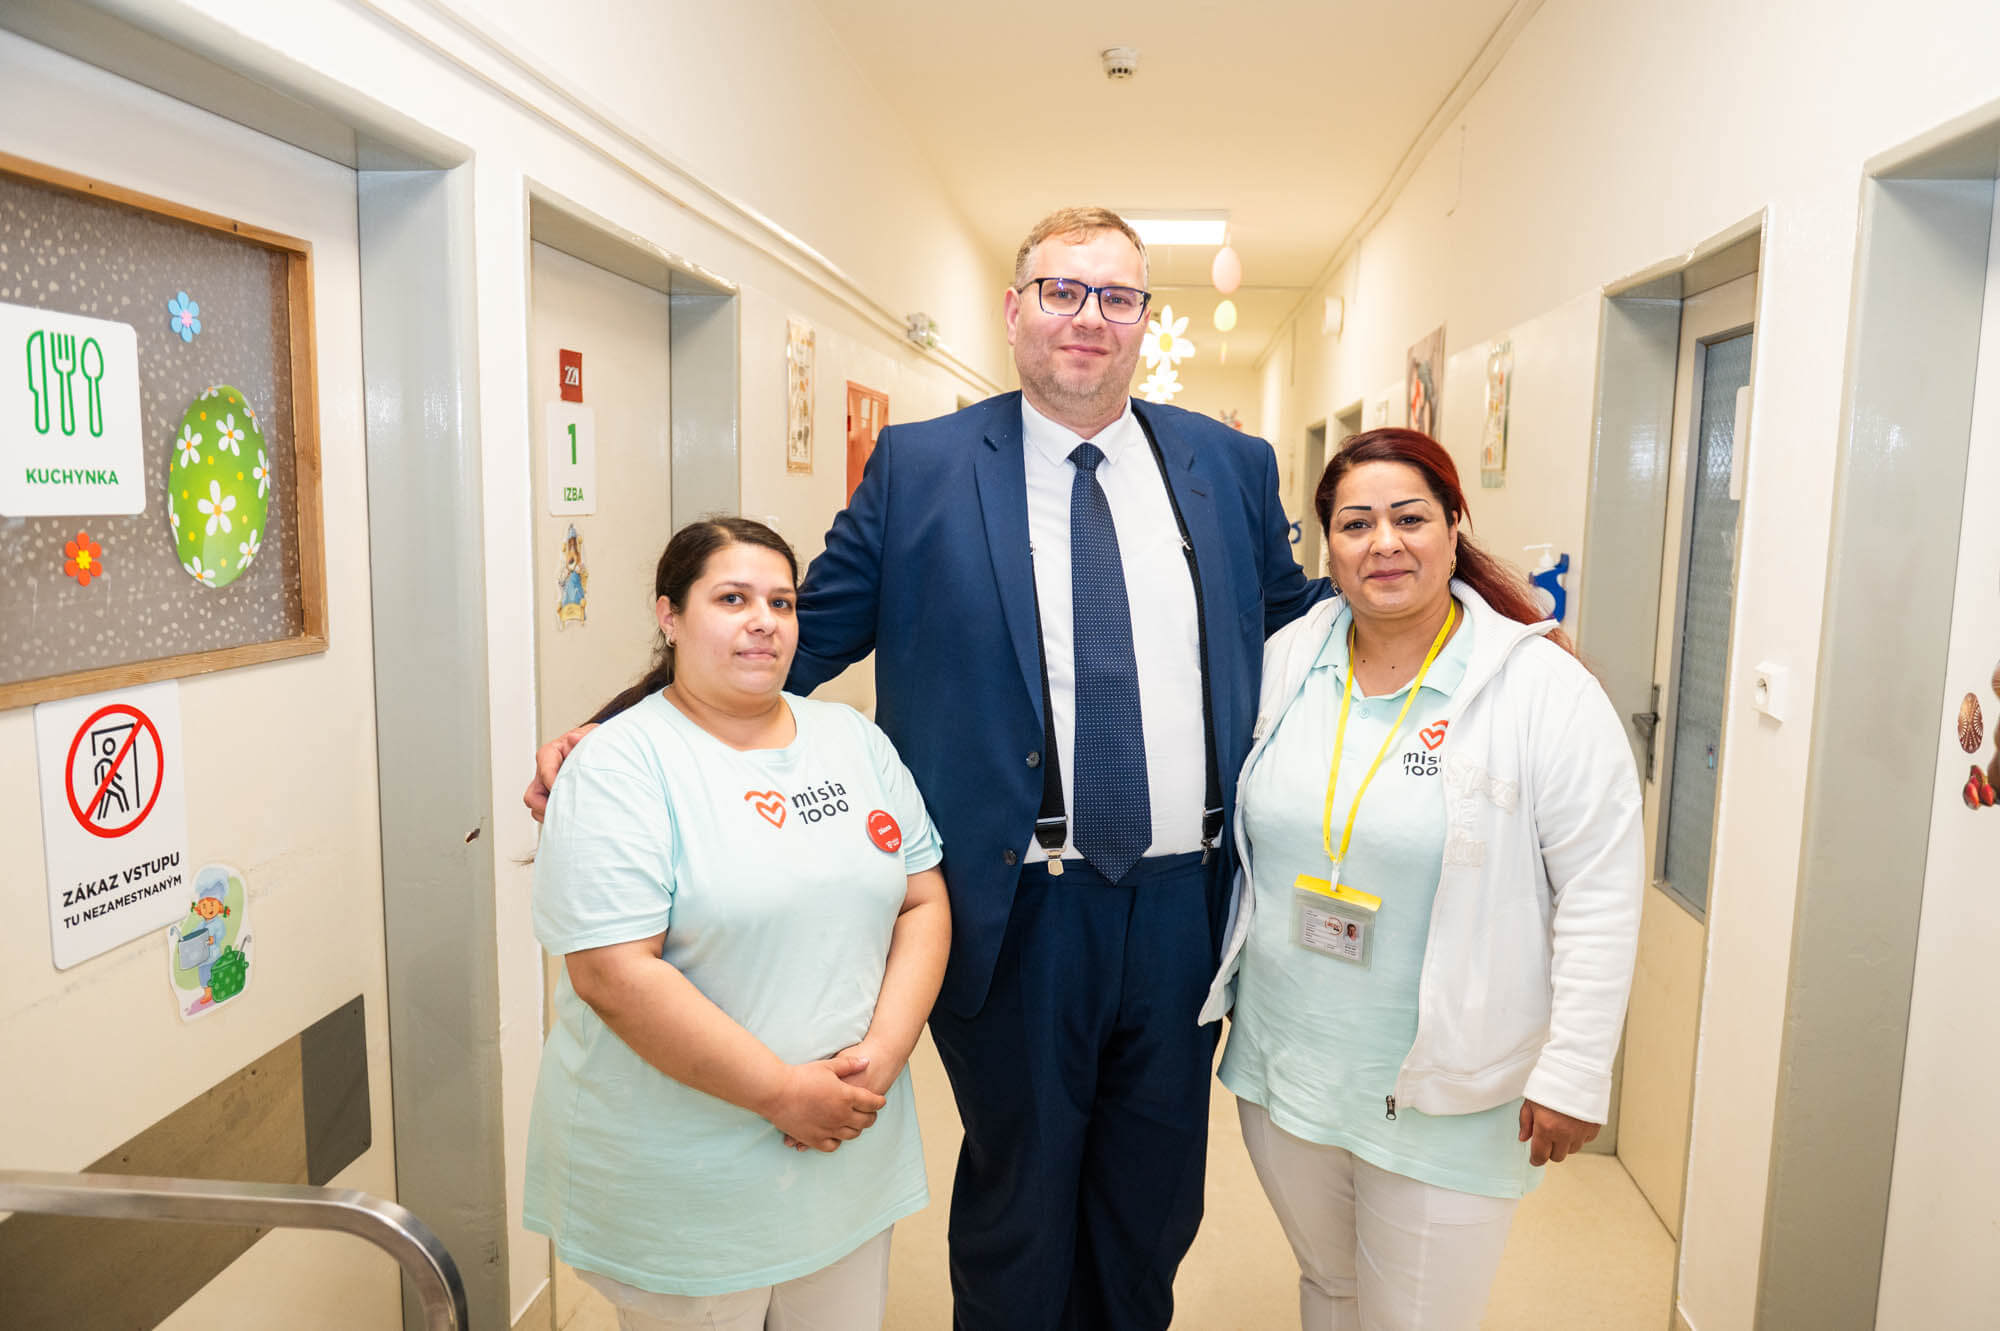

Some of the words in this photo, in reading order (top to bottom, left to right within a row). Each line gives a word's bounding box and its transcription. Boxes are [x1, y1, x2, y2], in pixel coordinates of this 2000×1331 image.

[567, 423, 577, 465] 1
[25, 467, 119, 485] KUCHYNKA
[563, 487, 584, 502] IZBA
[1404, 765, 1441, 776] 100
[791, 780, 847, 808] misia
[798, 799, 849, 825] 1000
[62, 873, 119, 908] ZÁKAZ
[122, 851, 180, 885] VSTUPU
[63, 914, 80, 929] TU
[83, 874, 182, 922] NEZAMESTNANÝM
